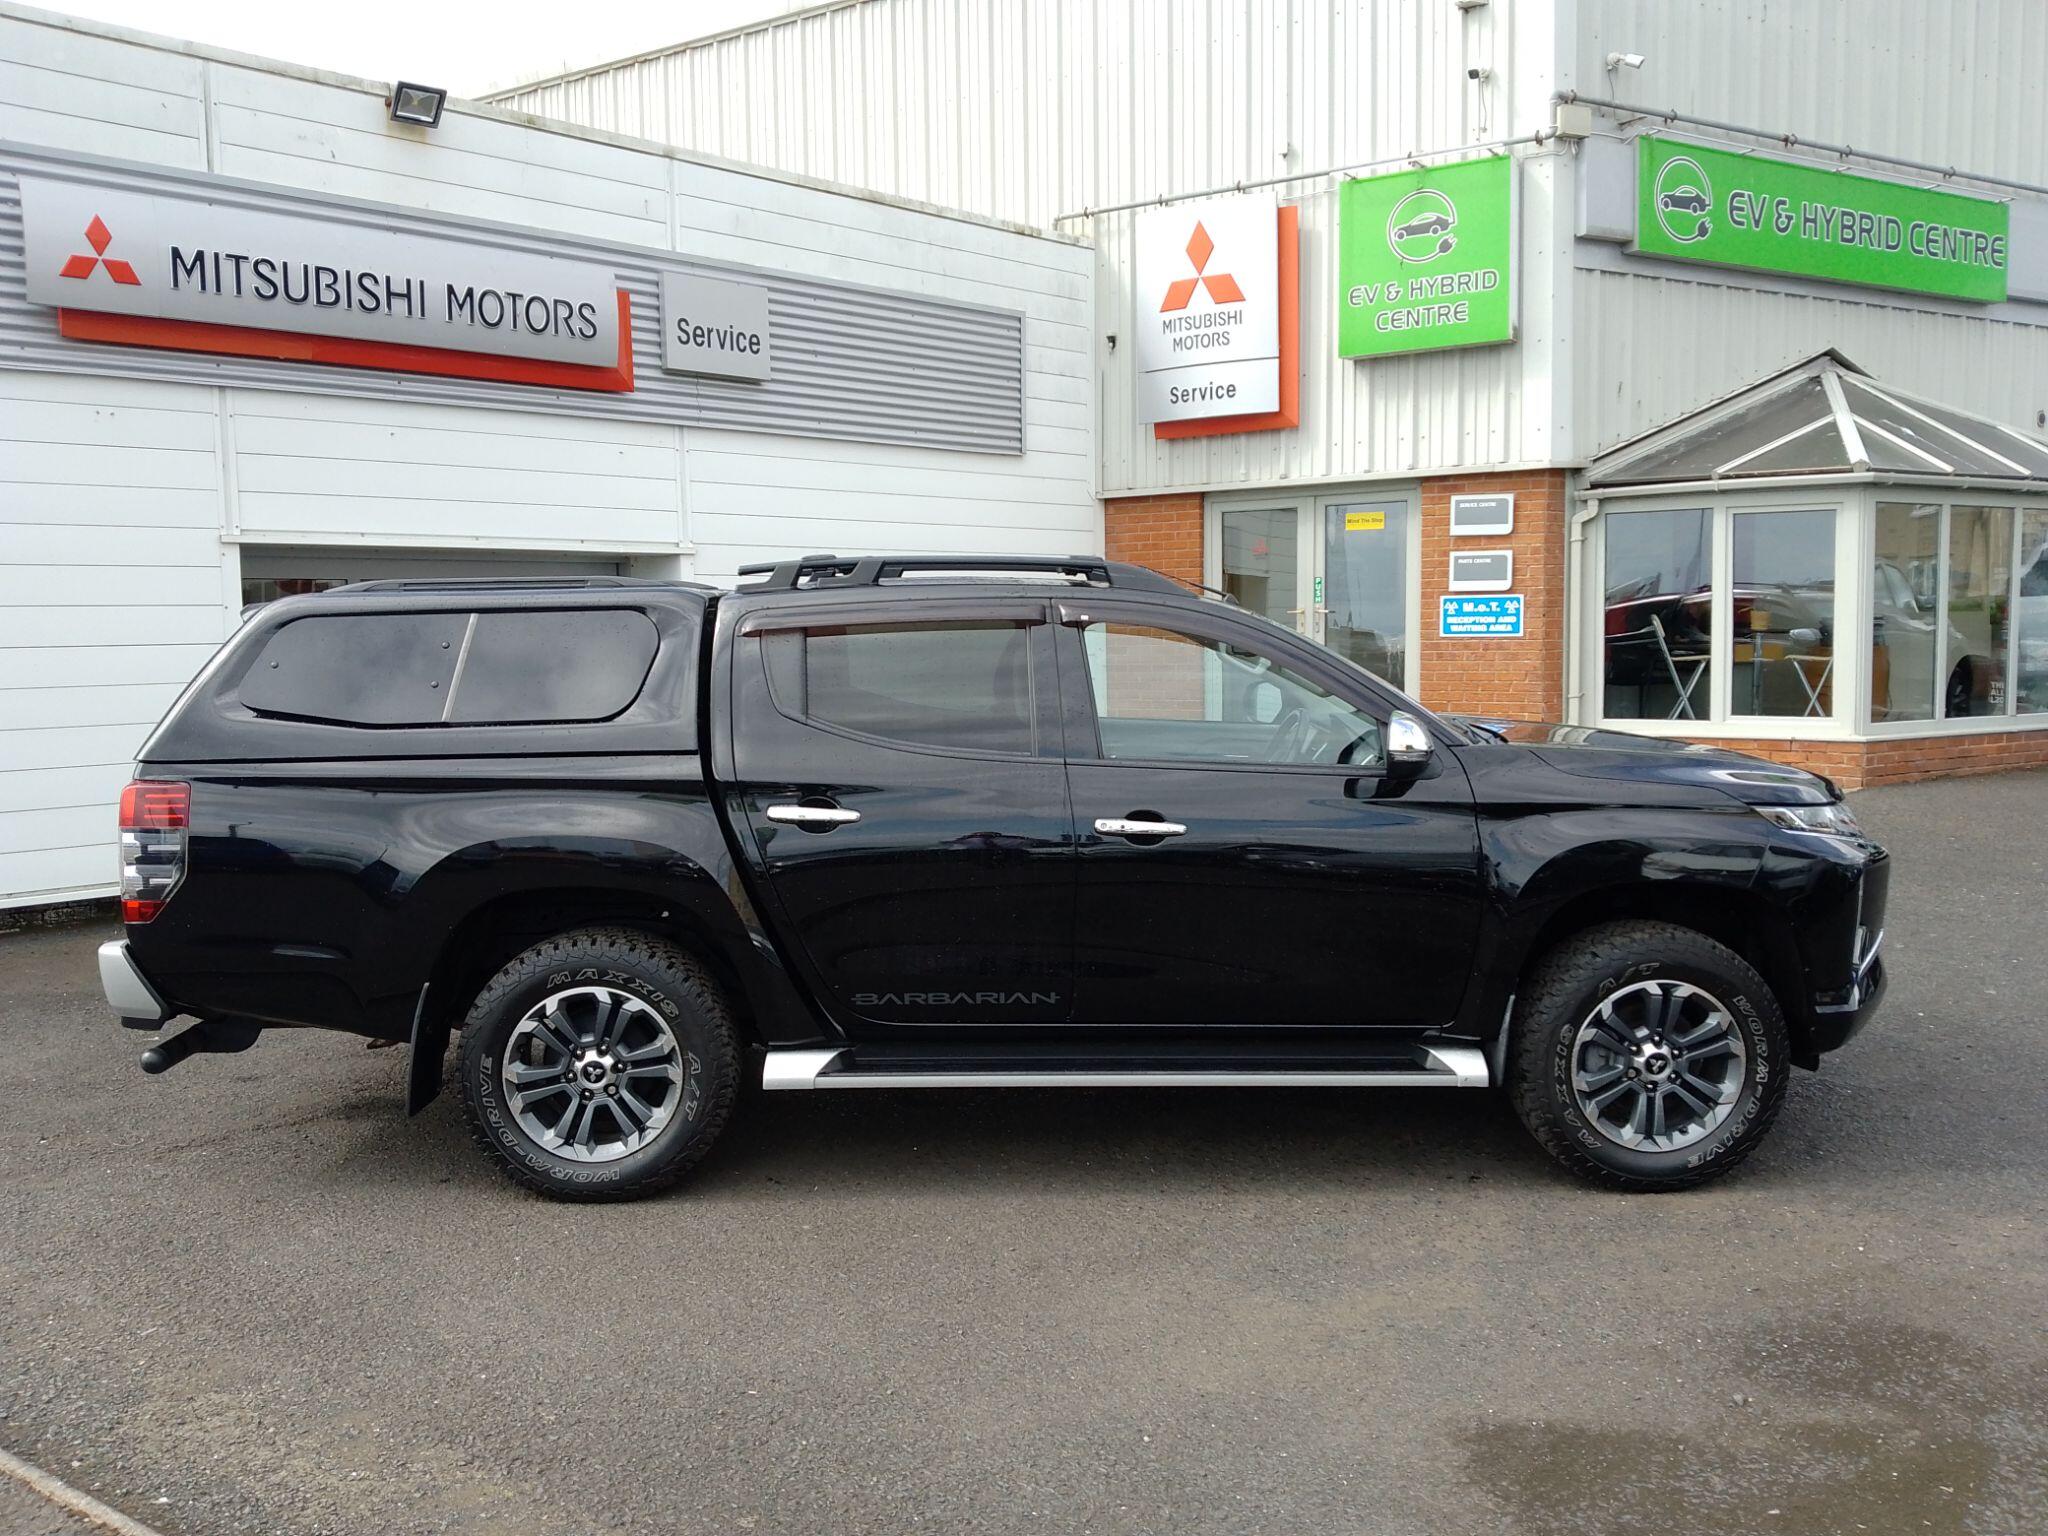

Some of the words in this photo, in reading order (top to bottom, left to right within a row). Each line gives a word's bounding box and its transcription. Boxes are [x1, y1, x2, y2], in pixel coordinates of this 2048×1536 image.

[1727, 189, 1768, 231] EV
[1774, 197, 1795, 236] &
[1802, 202, 1902, 252] HYBRID
[1909, 221, 2006, 270] CENTRE
[169, 244, 426, 321] MITSUBISHI
[445, 284, 599, 341] MOTORS
[1348, 284, 1380, 307] EV
[1385, 281, 1402, 303] &
[1409, 268, 1499, 300] HYBRID
[676, 315, 762, 356] Service
[1162, 309, 1243, 335] MITSUBISHI
[1375, 301, 1469, 332] CENTRE
[1172, 330, 1231, 353] MOTORS
[1169, 380, 1237, 405] Service
[1446, 615, 1497, 624] RECEPTION
[1497, 615, 1517, 623] AND
[546, 968, 680, 1019] MAXXIS
[851, 991, 1061, 1006] BARBARIAN
[684, 1051, 702, 1122] A/T
[1553, 1023, 1603, 1150] MAXXIS
[1687, 995, 1769, 1168] WORM-DRIVE
[479, 1053, 621, 1183] WORM-DRIVE
